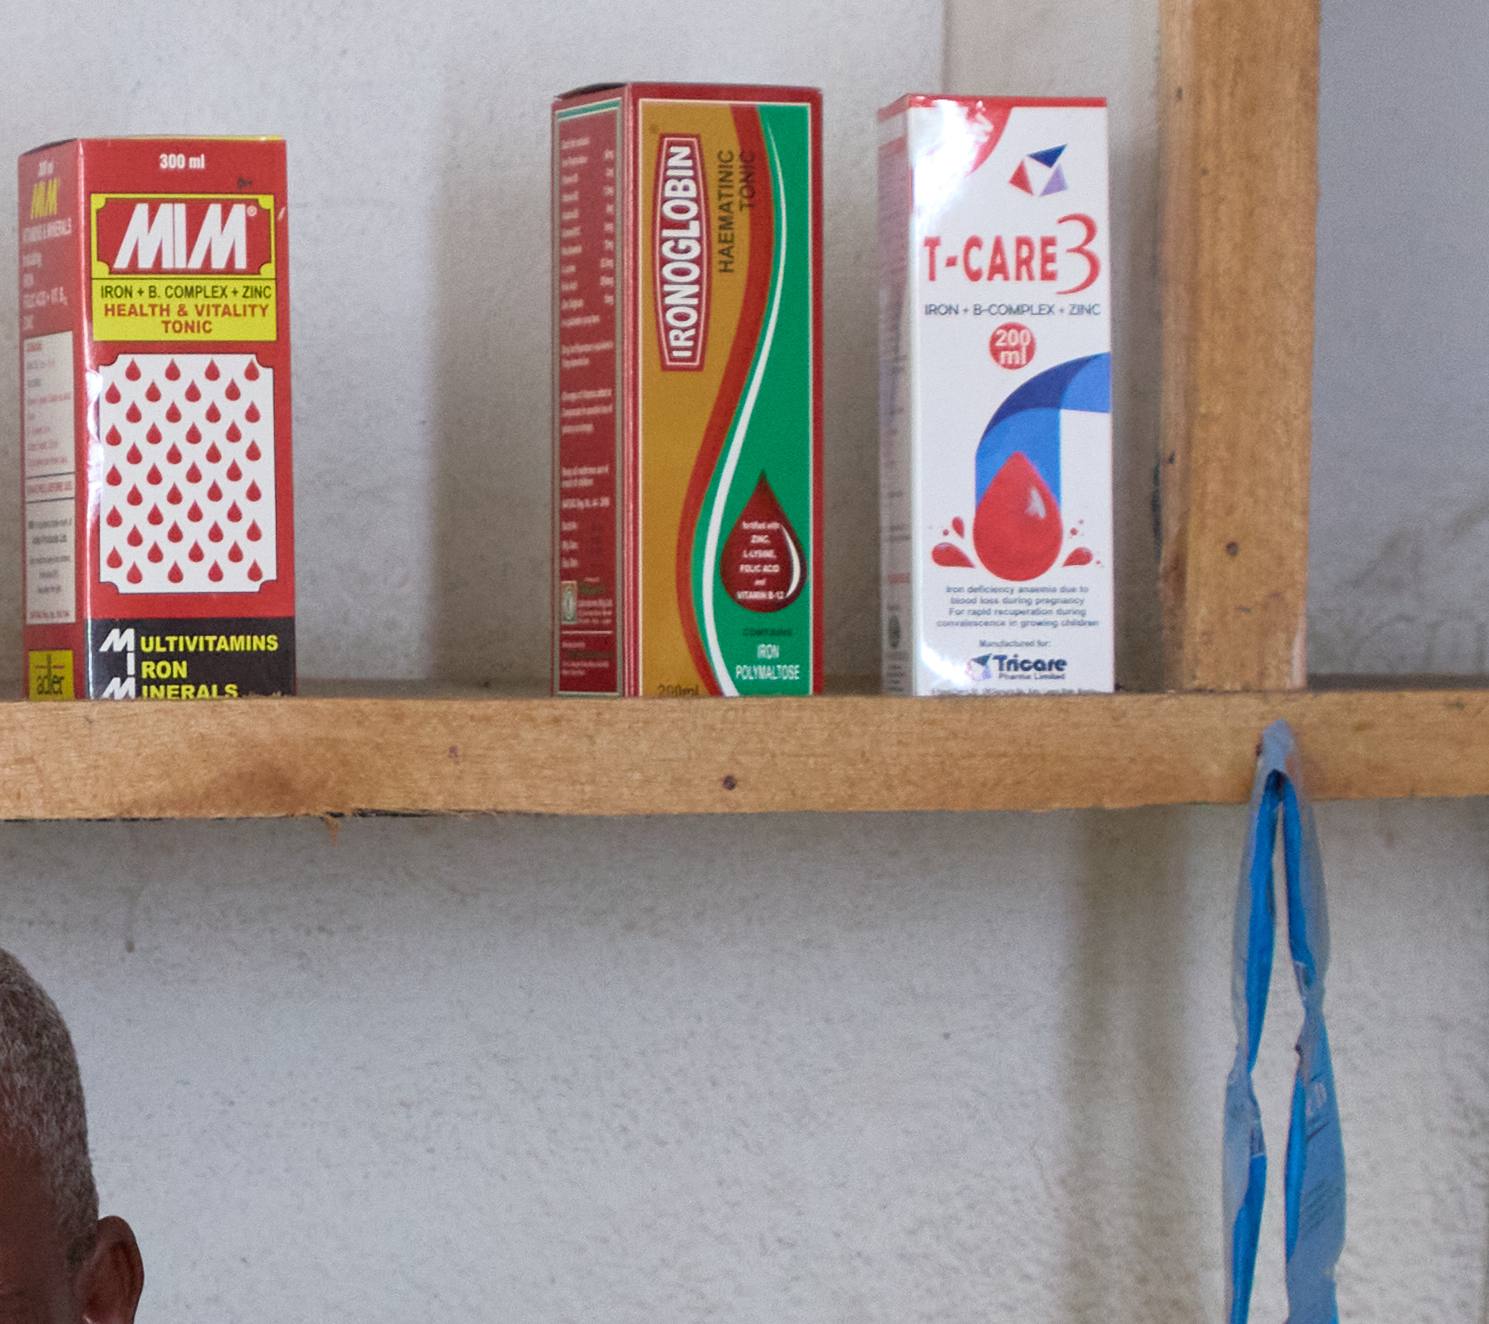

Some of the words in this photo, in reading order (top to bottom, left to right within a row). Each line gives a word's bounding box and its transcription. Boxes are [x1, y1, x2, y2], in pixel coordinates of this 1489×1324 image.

[718, 150, 735, 273] HAEMATINIC
[113, 203, 246, 269] MIM
[661, 146, 700, 357] IRONOGLOBIN
[925, 304, 959, 315] IRON
[973, 304, 1055, 315] B-COMPLEX
[1069, 304, 1101, 315] ZINC
[161, 320, 212, 333] TONIC
[995, 329, 1030, 346] 200
[1000, 349, 1027, 365] ml
[757, 644, 779, 658] IRON
[993, 654, 1068, 672] Tricare
[736, 665, 800, 680] POLYMALTOSE
